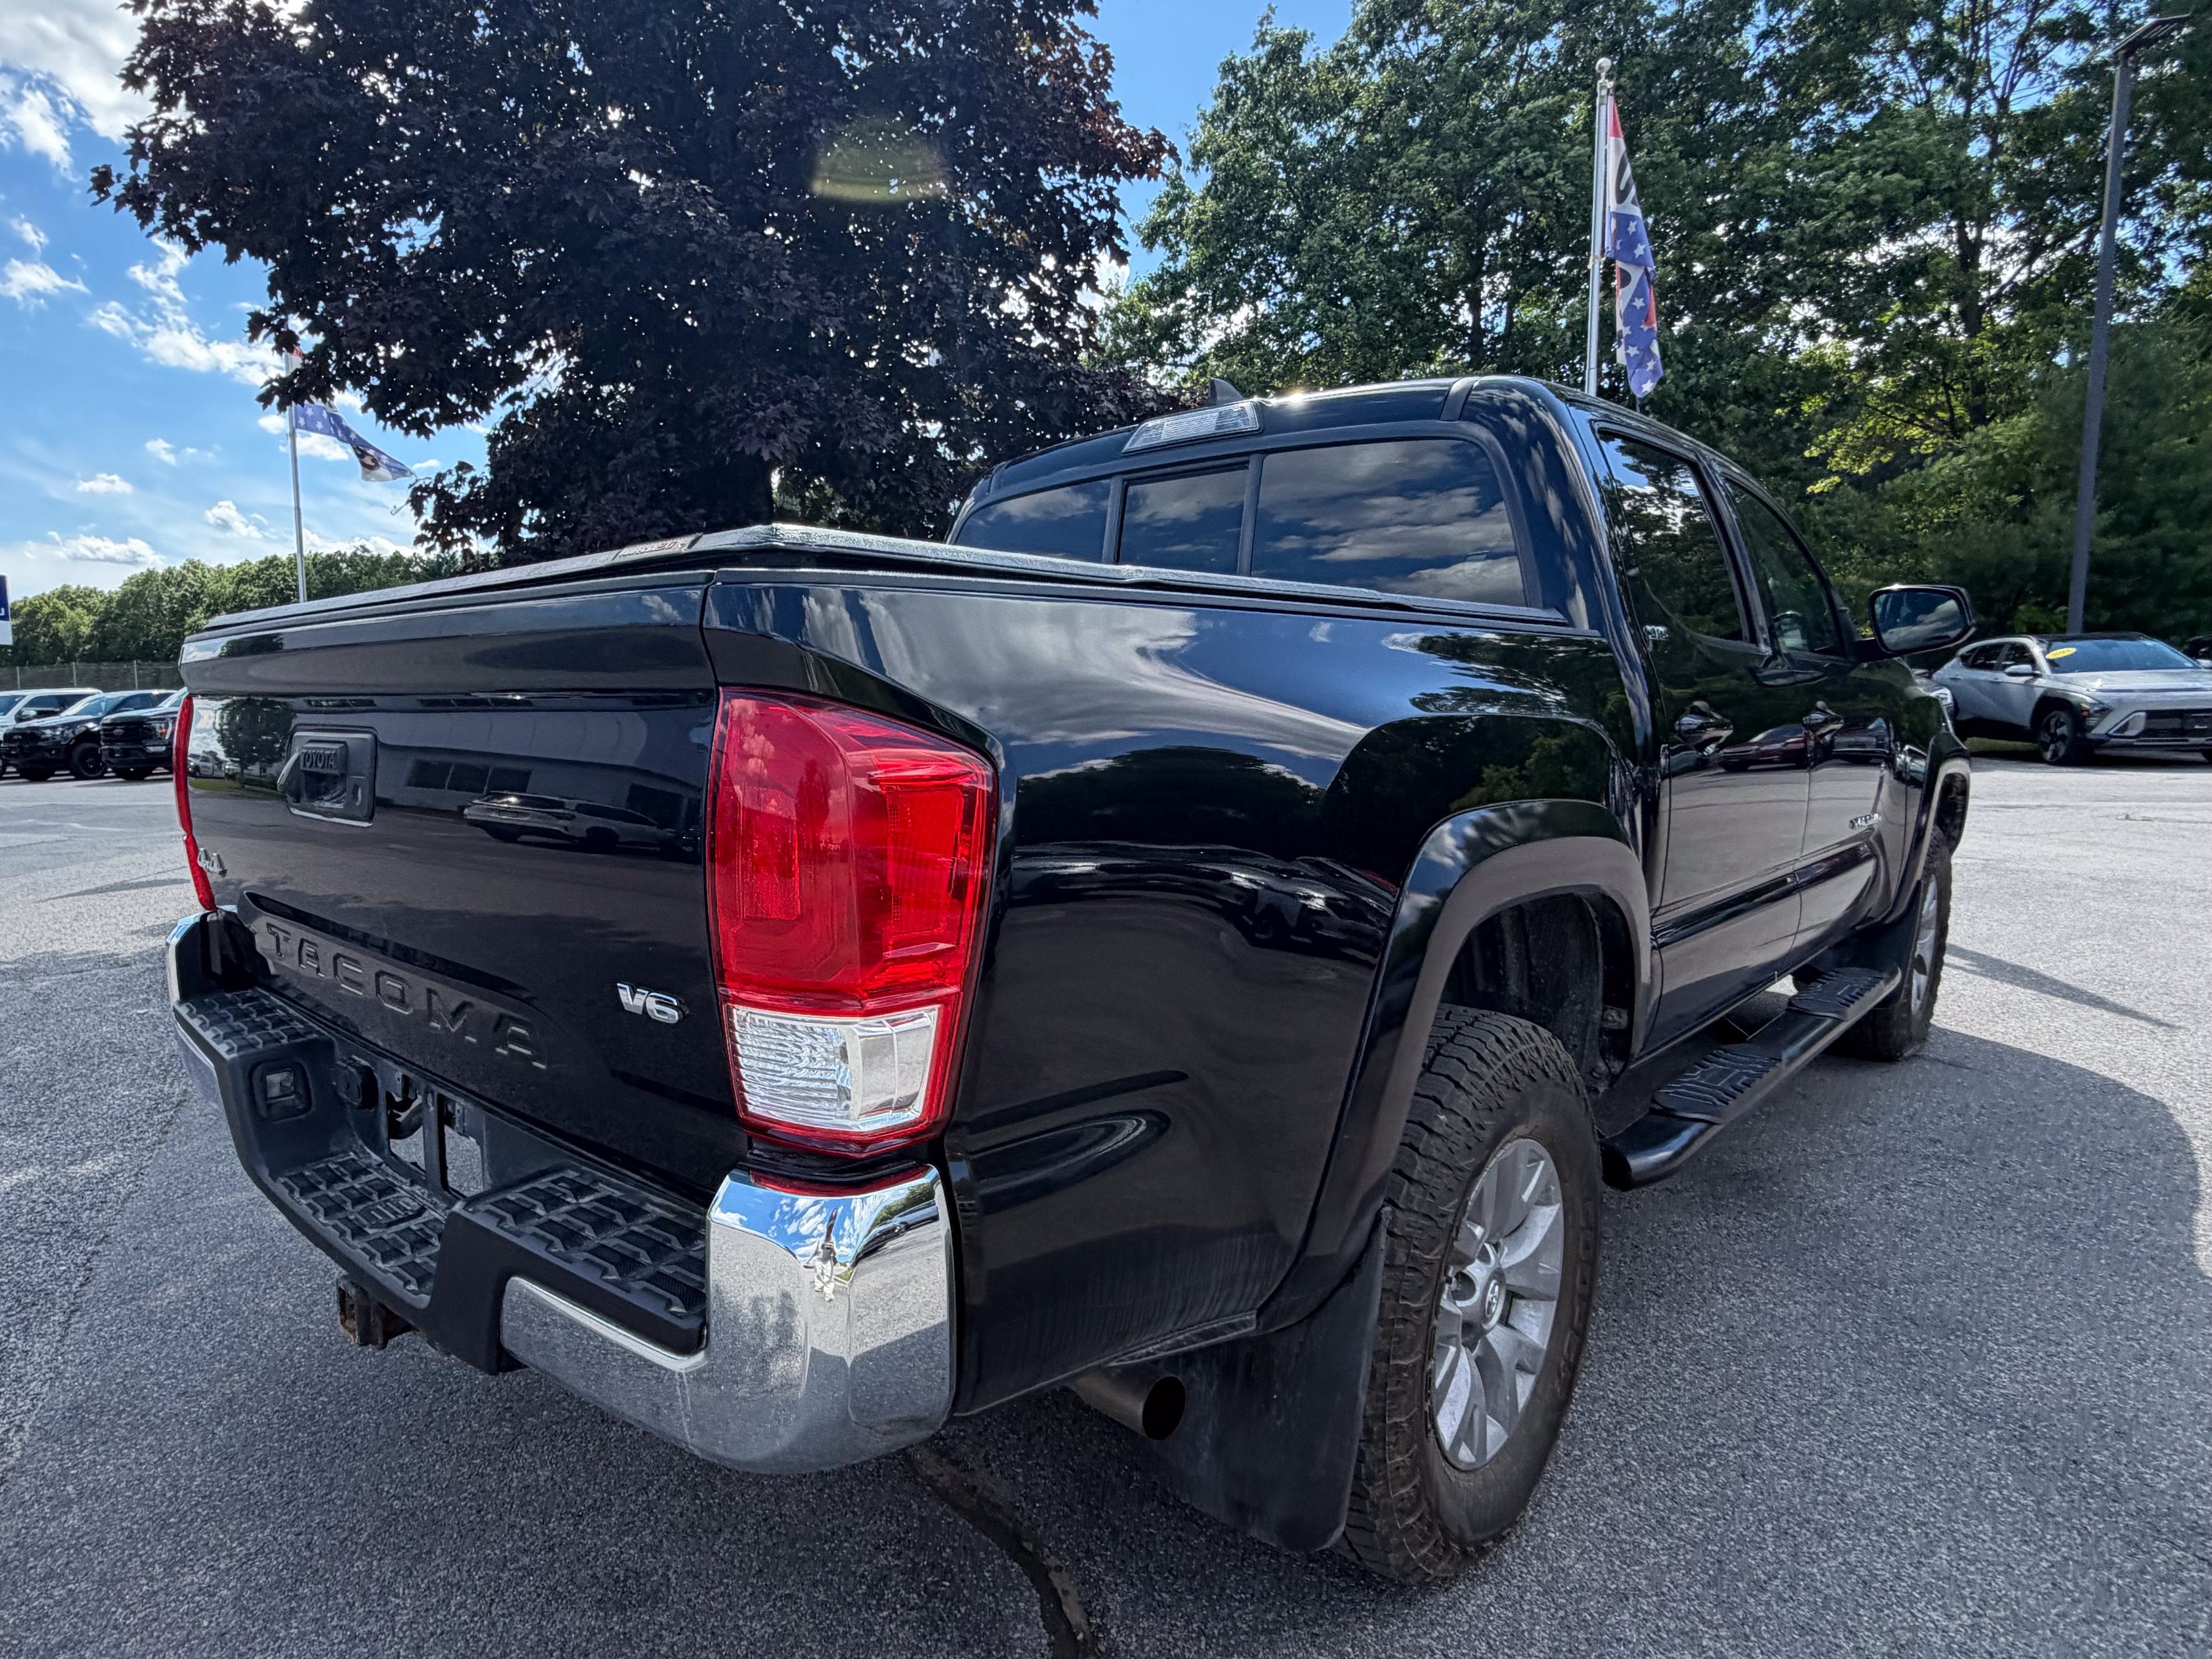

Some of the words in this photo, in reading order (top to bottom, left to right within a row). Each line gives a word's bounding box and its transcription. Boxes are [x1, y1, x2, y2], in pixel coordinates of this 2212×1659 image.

[300, 750, 339, 770] TOYOTA
[266, 922, 548, 1069] TACOMA
[616, 982, 682, 1024] V6
